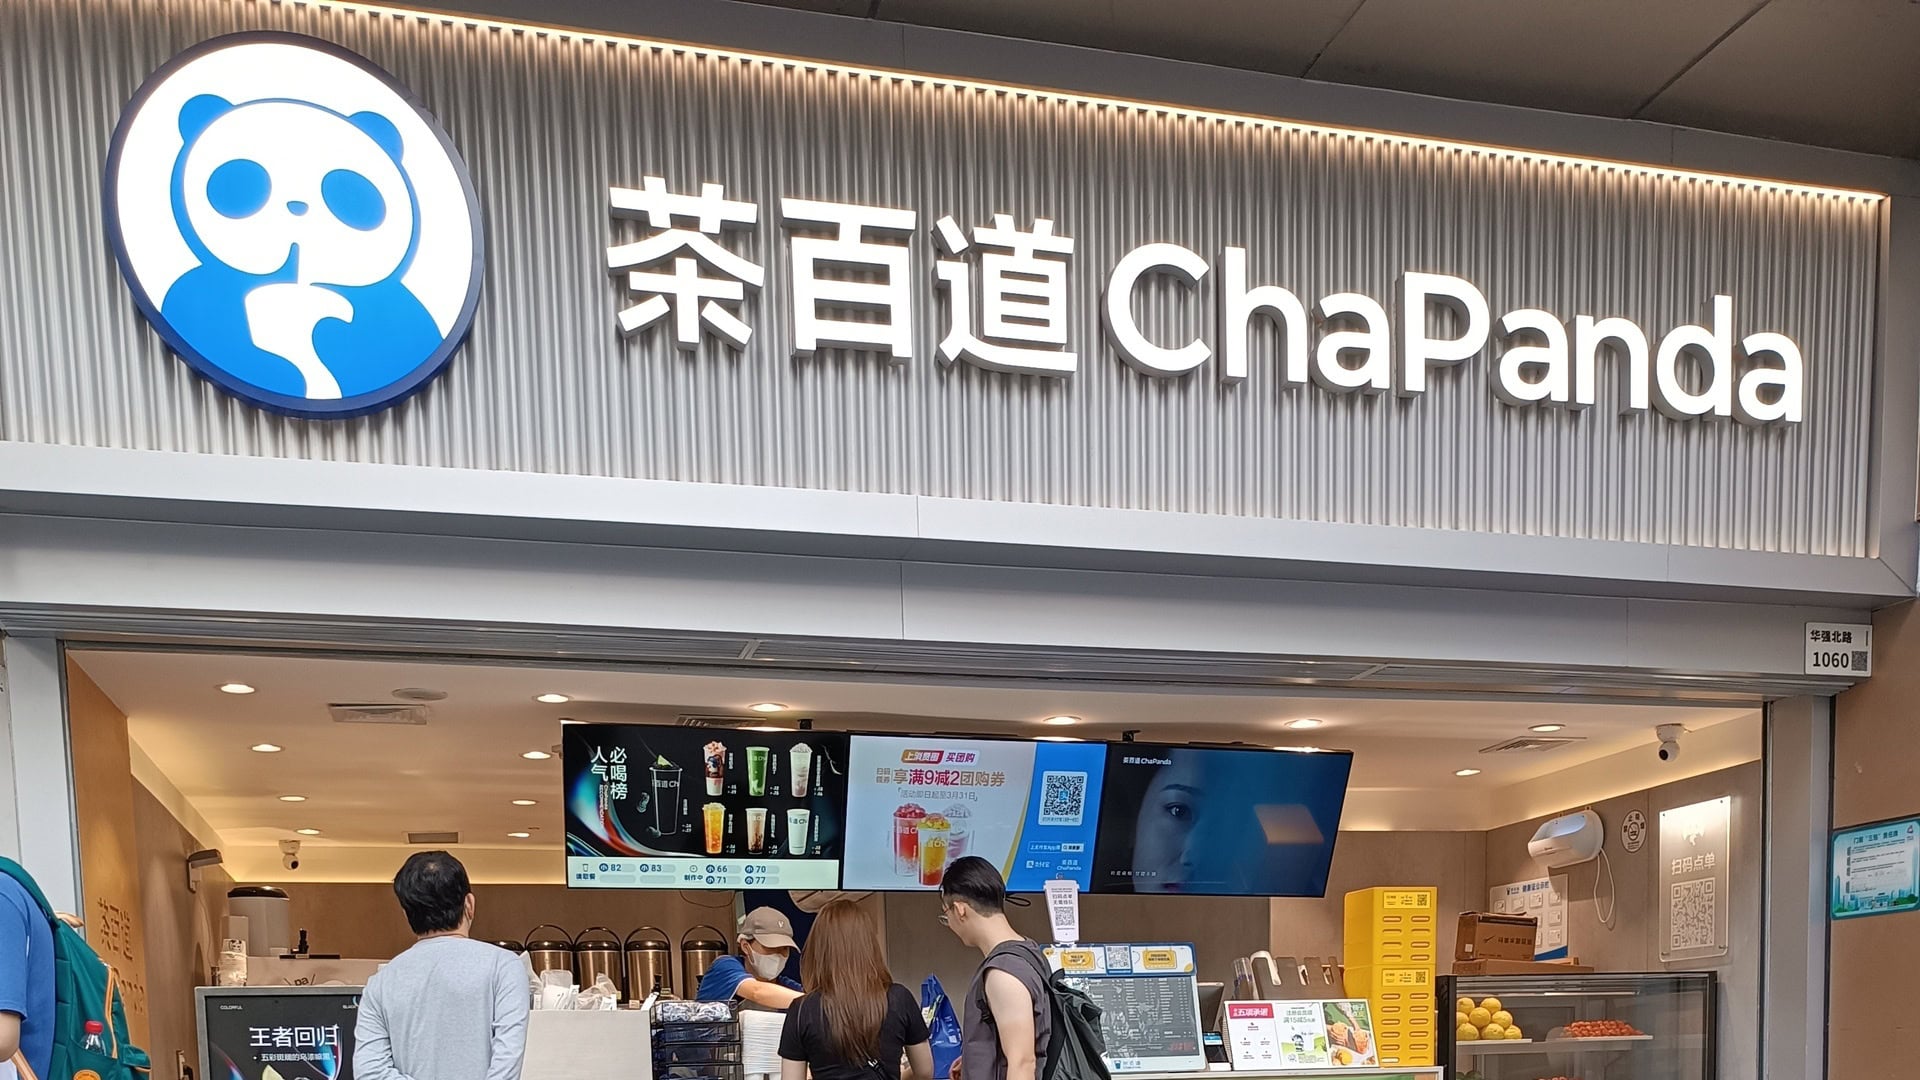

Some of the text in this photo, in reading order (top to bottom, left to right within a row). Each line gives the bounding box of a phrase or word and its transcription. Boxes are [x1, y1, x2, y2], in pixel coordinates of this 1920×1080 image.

[606, 176, 1803, 424] 茶百道 ChaPanda
[1810, 630, 1853, 644] 华强北路
[1813, 652, 1849, 668] 1060
[590, 745, 609, 782] 人气
[946, 752, 976, 763] 买团购
[610, 746, 628, 800] 必喝榜
[893, 768, 1005, 787] 享满9减2团购券
[610, 864, 622, 872] 82
[717, 865, 767, 873] 66 70
[1671, 852, 1716, 876] 扫码点单
[249, 1025, 338, 1048] 王者回归
